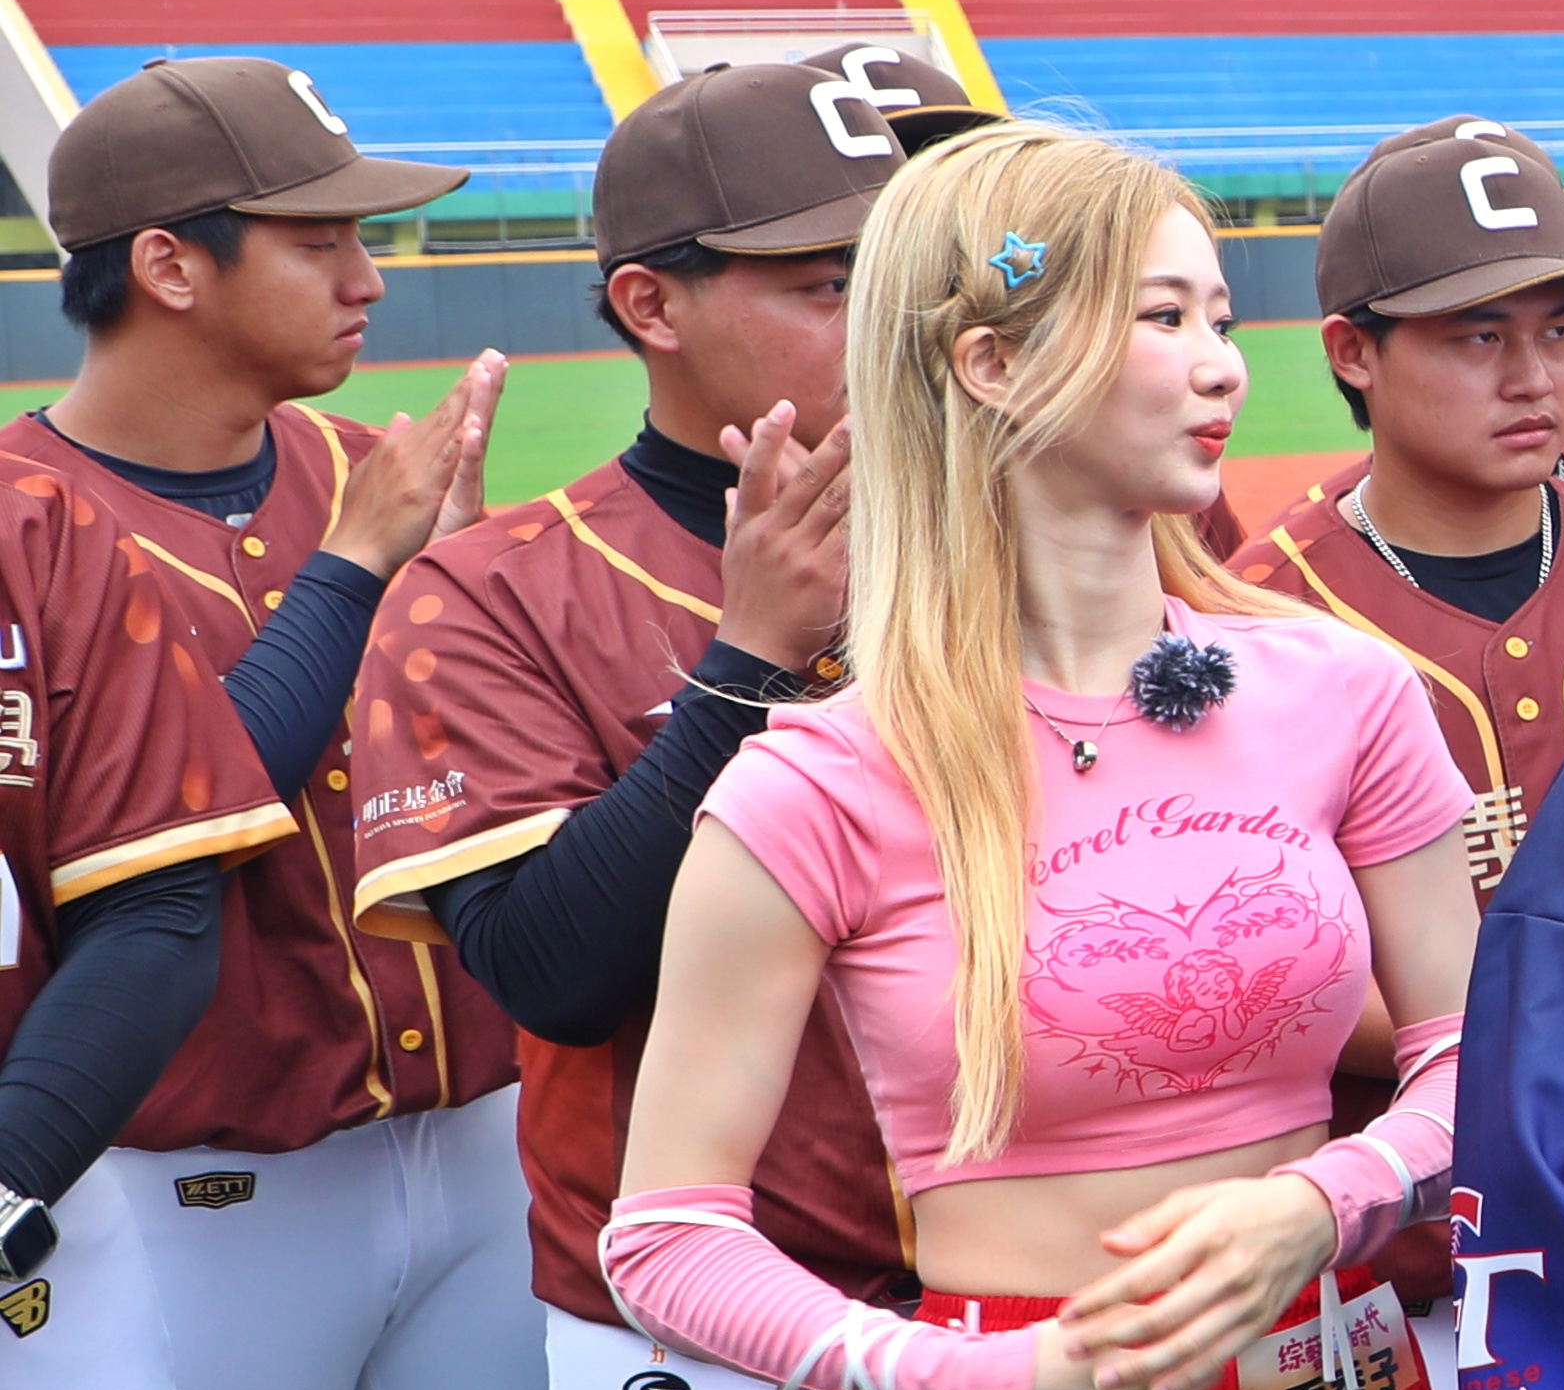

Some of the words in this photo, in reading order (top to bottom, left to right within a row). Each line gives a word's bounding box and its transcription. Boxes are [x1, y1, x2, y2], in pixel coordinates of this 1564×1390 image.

[288, 70, 348, 136] C
[809, 80, 893, 159] C
[1460, 155, 1539, 231] C
[1136, 793, 1312, 852] Garden
[185, 1178, 247, 1196] ZETT
